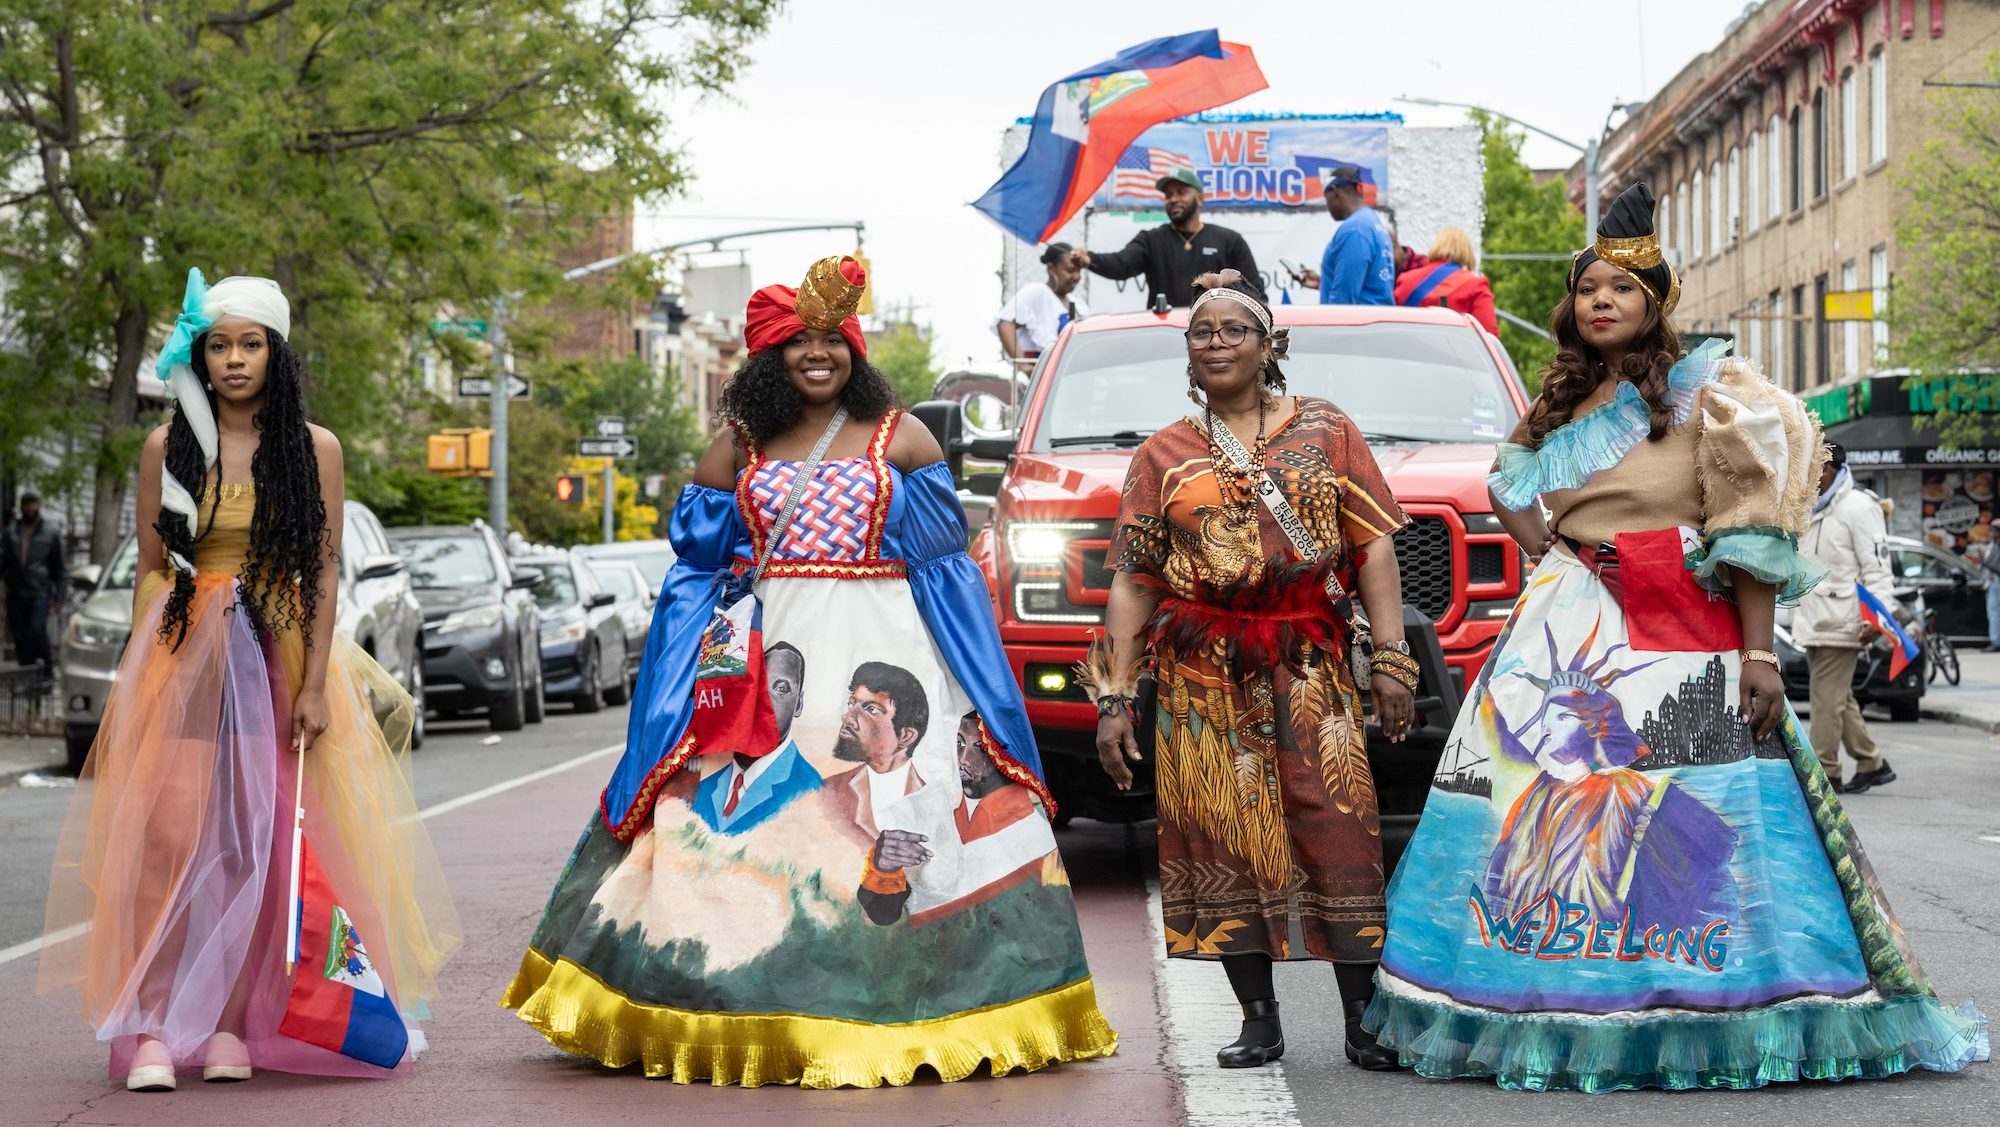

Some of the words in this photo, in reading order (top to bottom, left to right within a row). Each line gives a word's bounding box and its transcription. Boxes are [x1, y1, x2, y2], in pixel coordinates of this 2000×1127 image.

[1204, 129, 1269, 165] WE
[1195, 167, 1305, 206] ELONG
[1925, 449, 1985, 463] ORGANIC
[1272, 506, 1316, 562] AOXIONG
[1279, 501, 1319, 558] BEIBAOBA
[694, 688, 723, 710] AH
[1467, 883, 1549, 954] WE
[1535, 888, 1731, 972] BELONG
